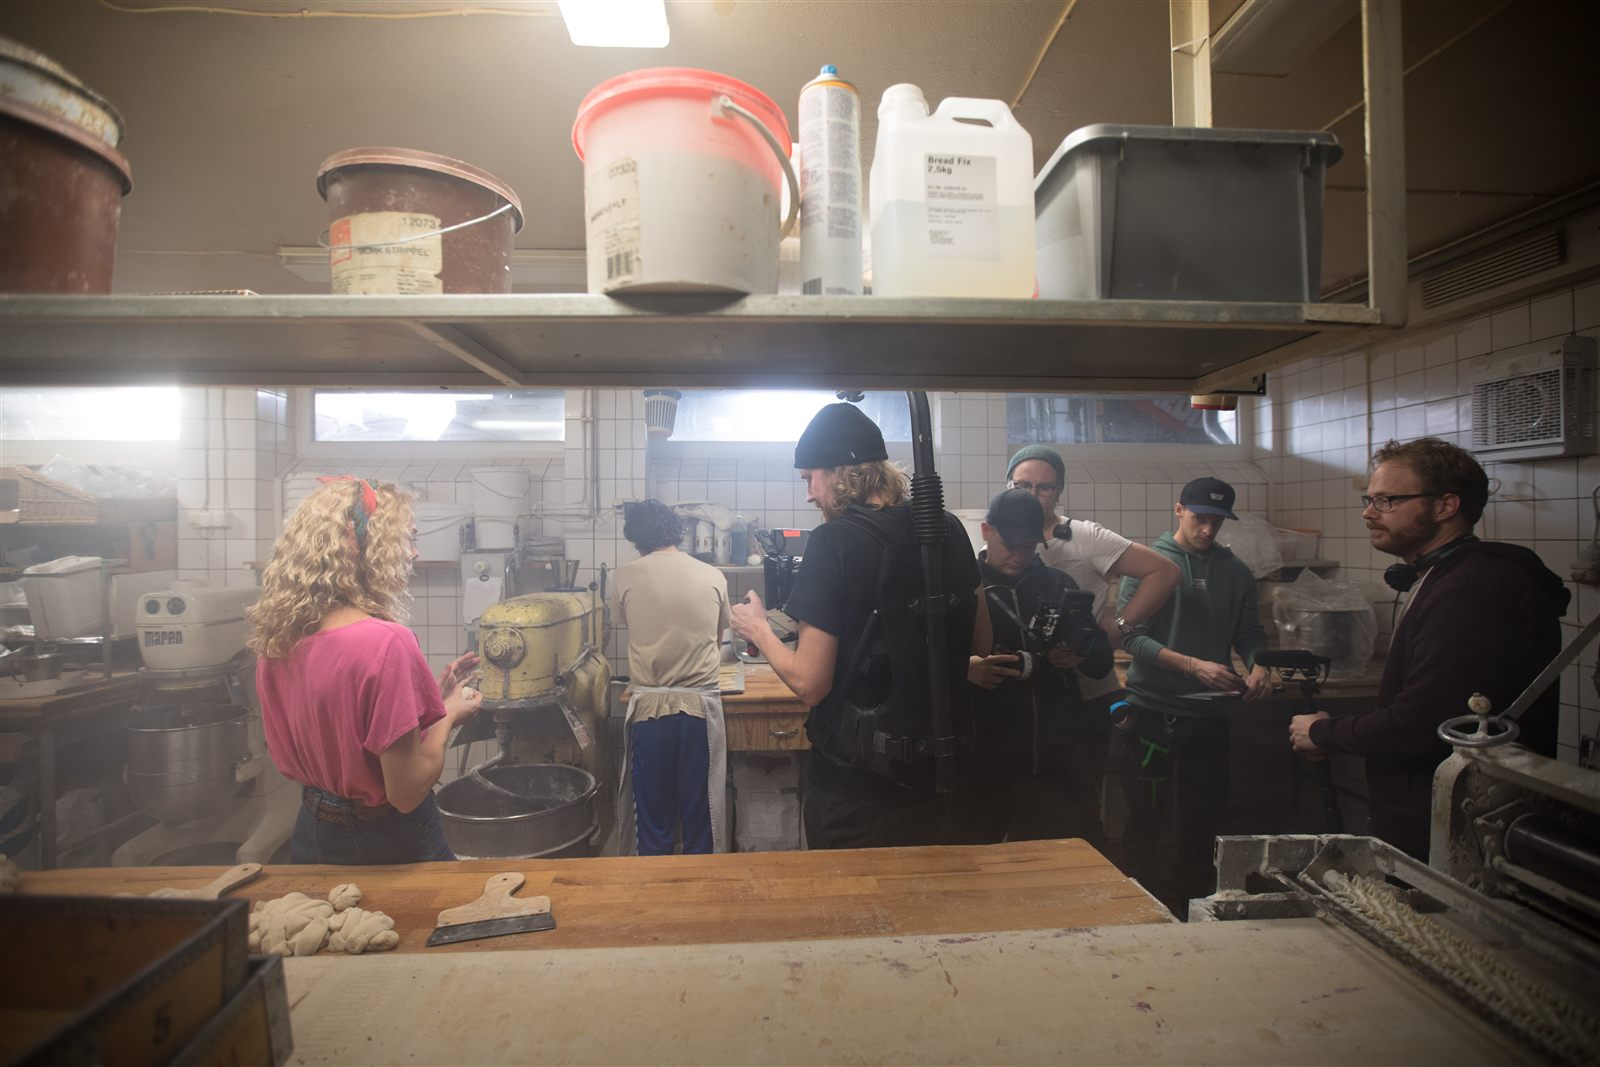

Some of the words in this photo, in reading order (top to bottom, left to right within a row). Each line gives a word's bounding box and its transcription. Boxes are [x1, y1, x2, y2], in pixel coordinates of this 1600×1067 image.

[928, 156, 954, 165] Bread
[957, 157, 971, 166] Fix
[927, 166, 952, 175] 2.5kg
[402, 217, 437, 229] 12073
